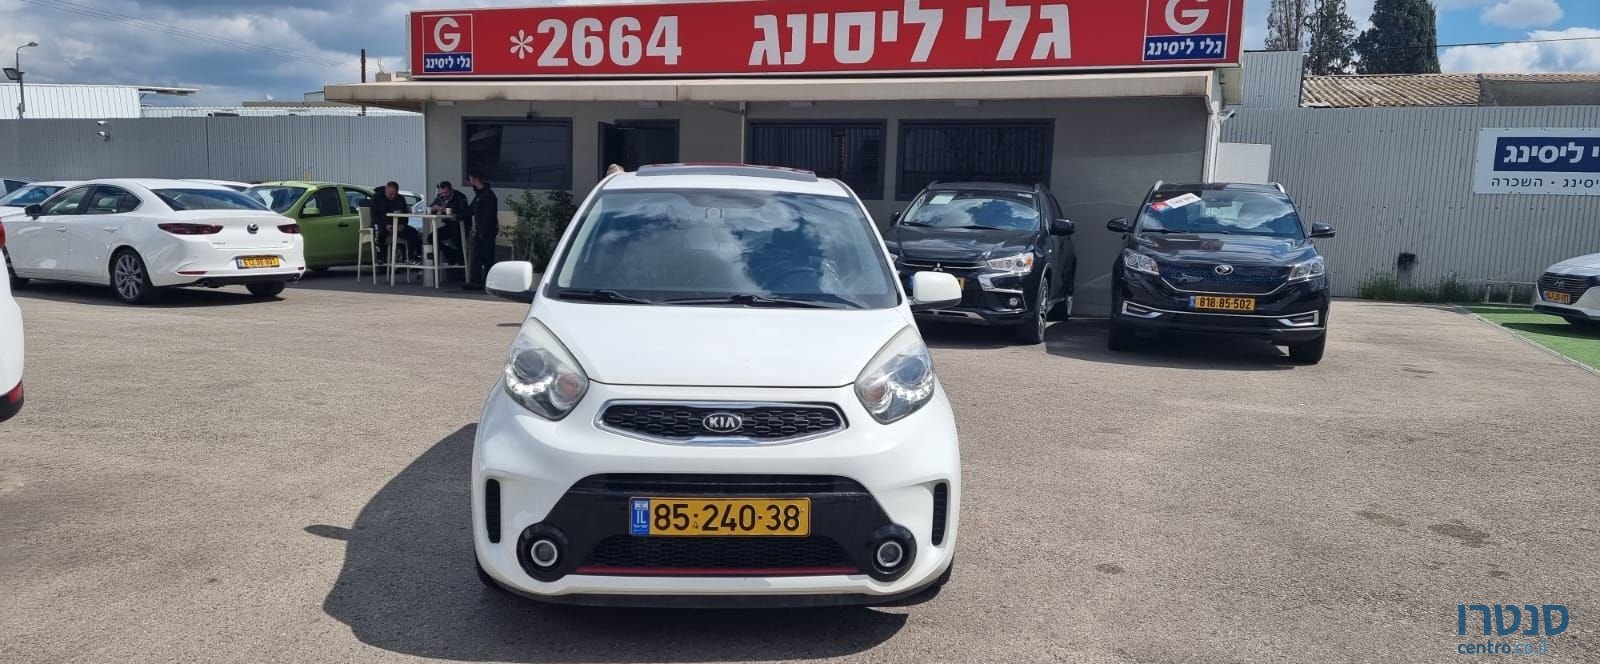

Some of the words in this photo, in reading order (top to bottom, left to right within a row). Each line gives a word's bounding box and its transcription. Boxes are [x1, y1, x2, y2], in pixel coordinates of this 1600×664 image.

[1164, 0, 1210, 34] G
[433, 16, 461, 52] G
[748, 0, 944, 65] ליסינג
[964, 0, 1072, 61] גלי
[1146, 38, 1195, 56] ליסינג
[1199, 37, 1223, 54] גלי
[425, 55, 454, 69] ליסינג
[456, 55, 471, 68] גלי
[1503, 141, 1585, 164] ליסינג
[1491, 177, 1543, 187] השכרה
[1562, 178, 1599, 189] יסינג
[709, 416, 736, 428] KIA
[636, 510, 647, 524] IL
